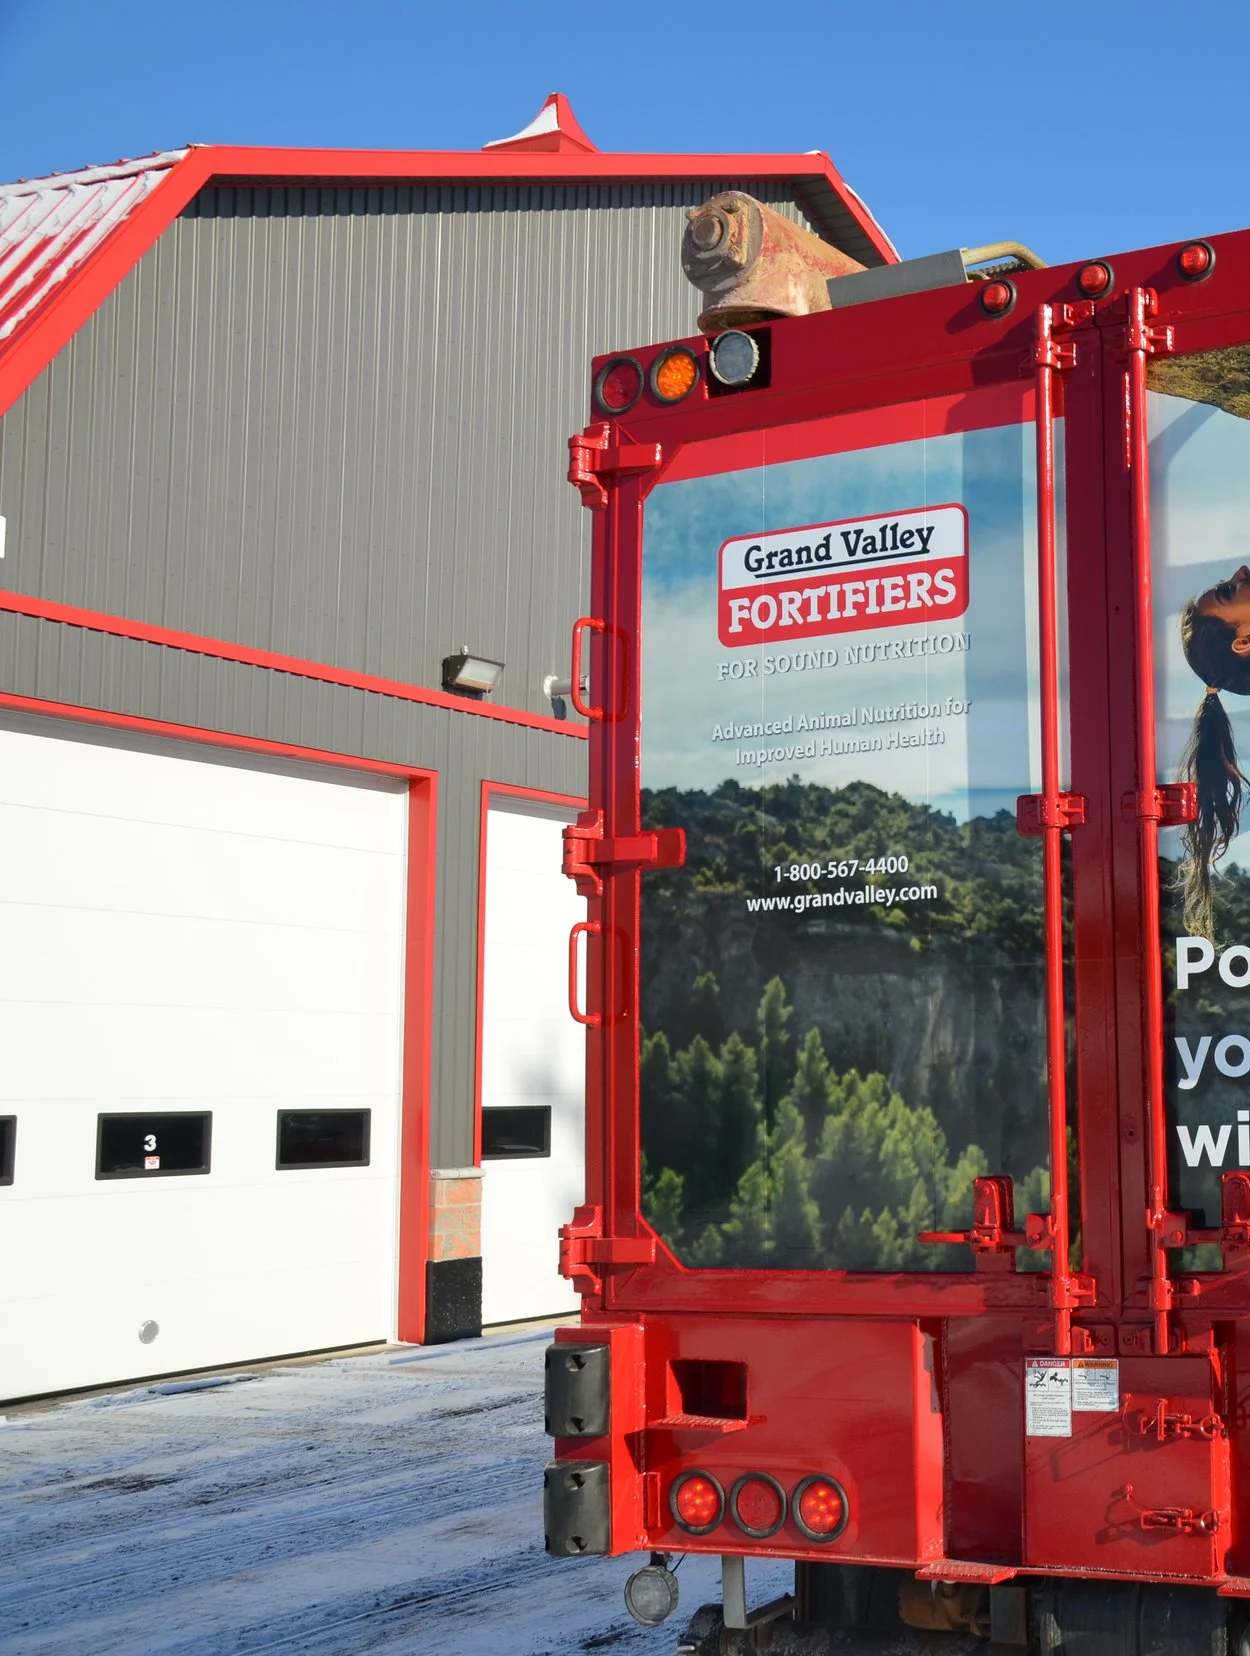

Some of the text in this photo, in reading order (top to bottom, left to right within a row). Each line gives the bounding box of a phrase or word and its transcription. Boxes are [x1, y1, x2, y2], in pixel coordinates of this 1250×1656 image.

[744, 522, 935, 573] Grand Valley
[728, 568, 957, 634] FORTIFIERS
[716, 632, 971, 681] FOR SOUND NUTRITION
[711, 697, 972, 742] Advanced Animal Nutrition for
[735, 727, 945, 767] Improved Human Health
[774, 856, 909, 883] 1-800-567-4400
[747, 884, 938, 913] www.grandvalley.com
[144, 1134, 157, 1152] 3
